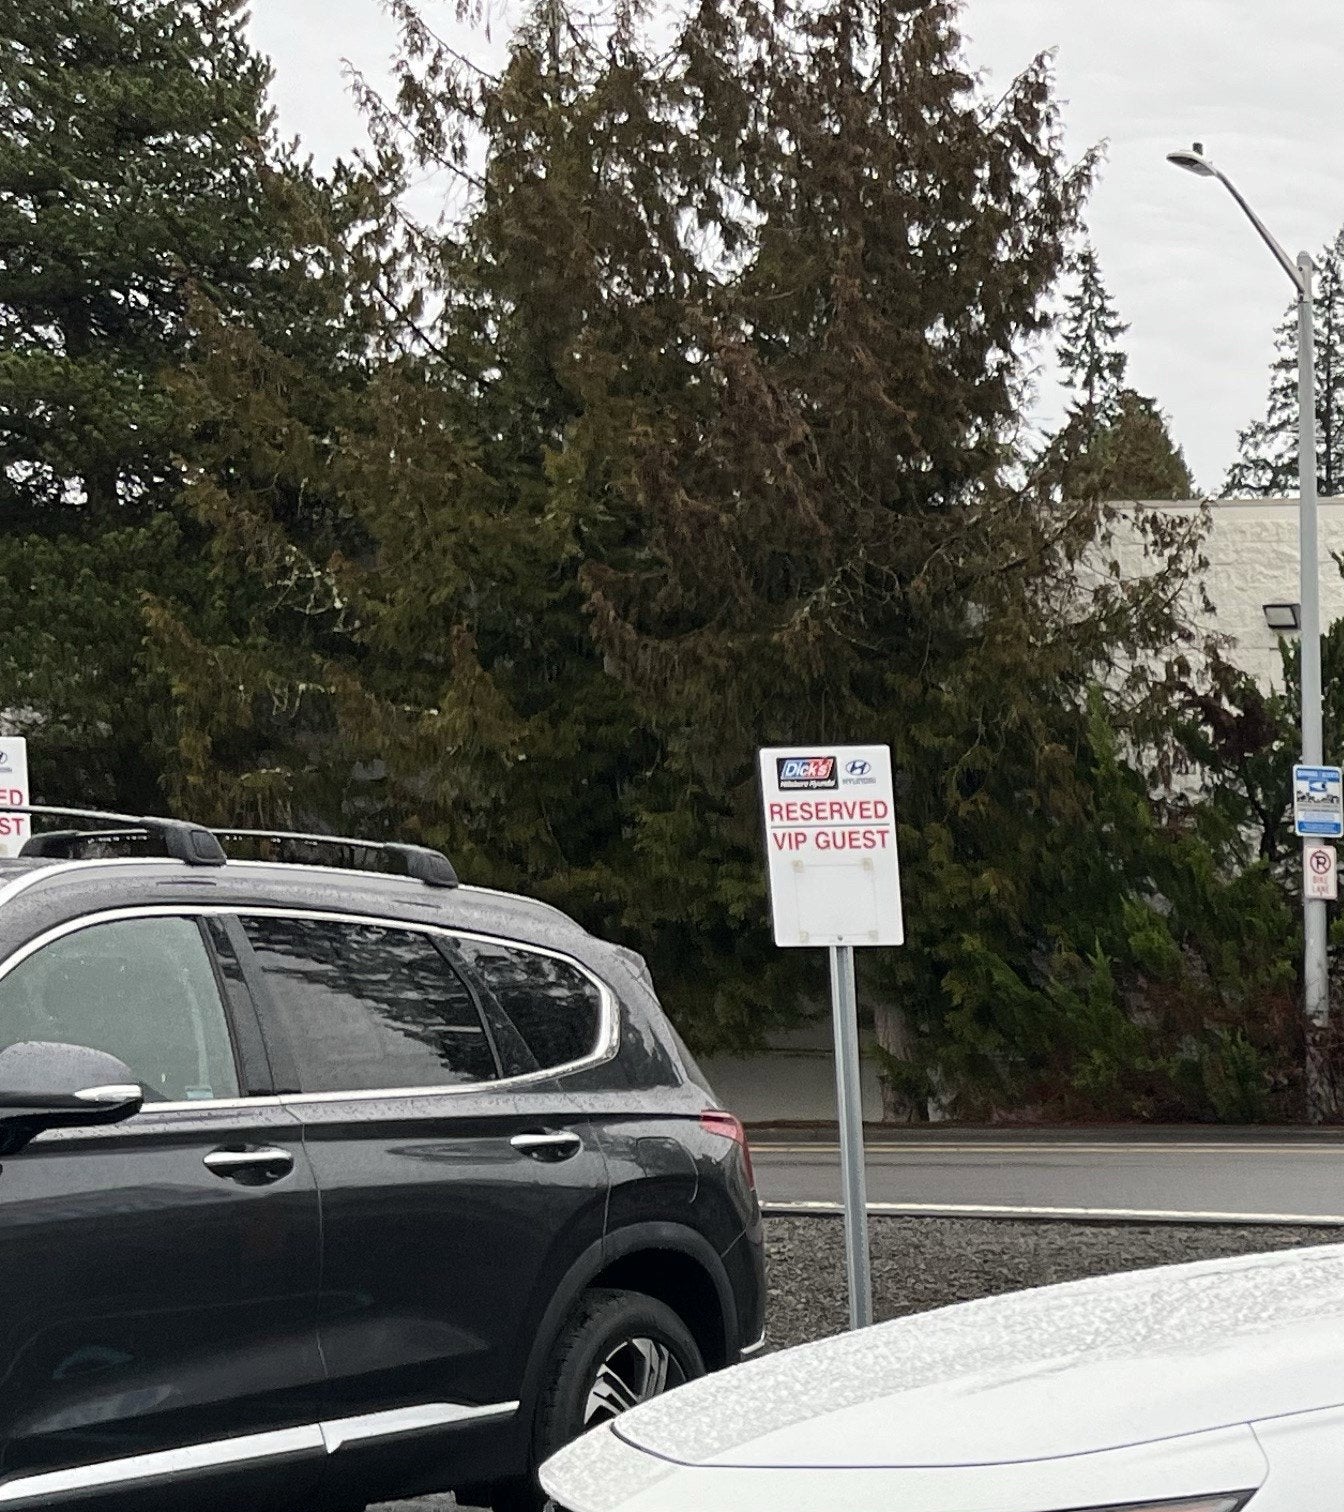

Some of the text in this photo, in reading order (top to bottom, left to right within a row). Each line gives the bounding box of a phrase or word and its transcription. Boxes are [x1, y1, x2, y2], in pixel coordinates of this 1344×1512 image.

[769, 800, 889, 822] RESERVED
[773, 830, 890, 850] VIP GUEST
